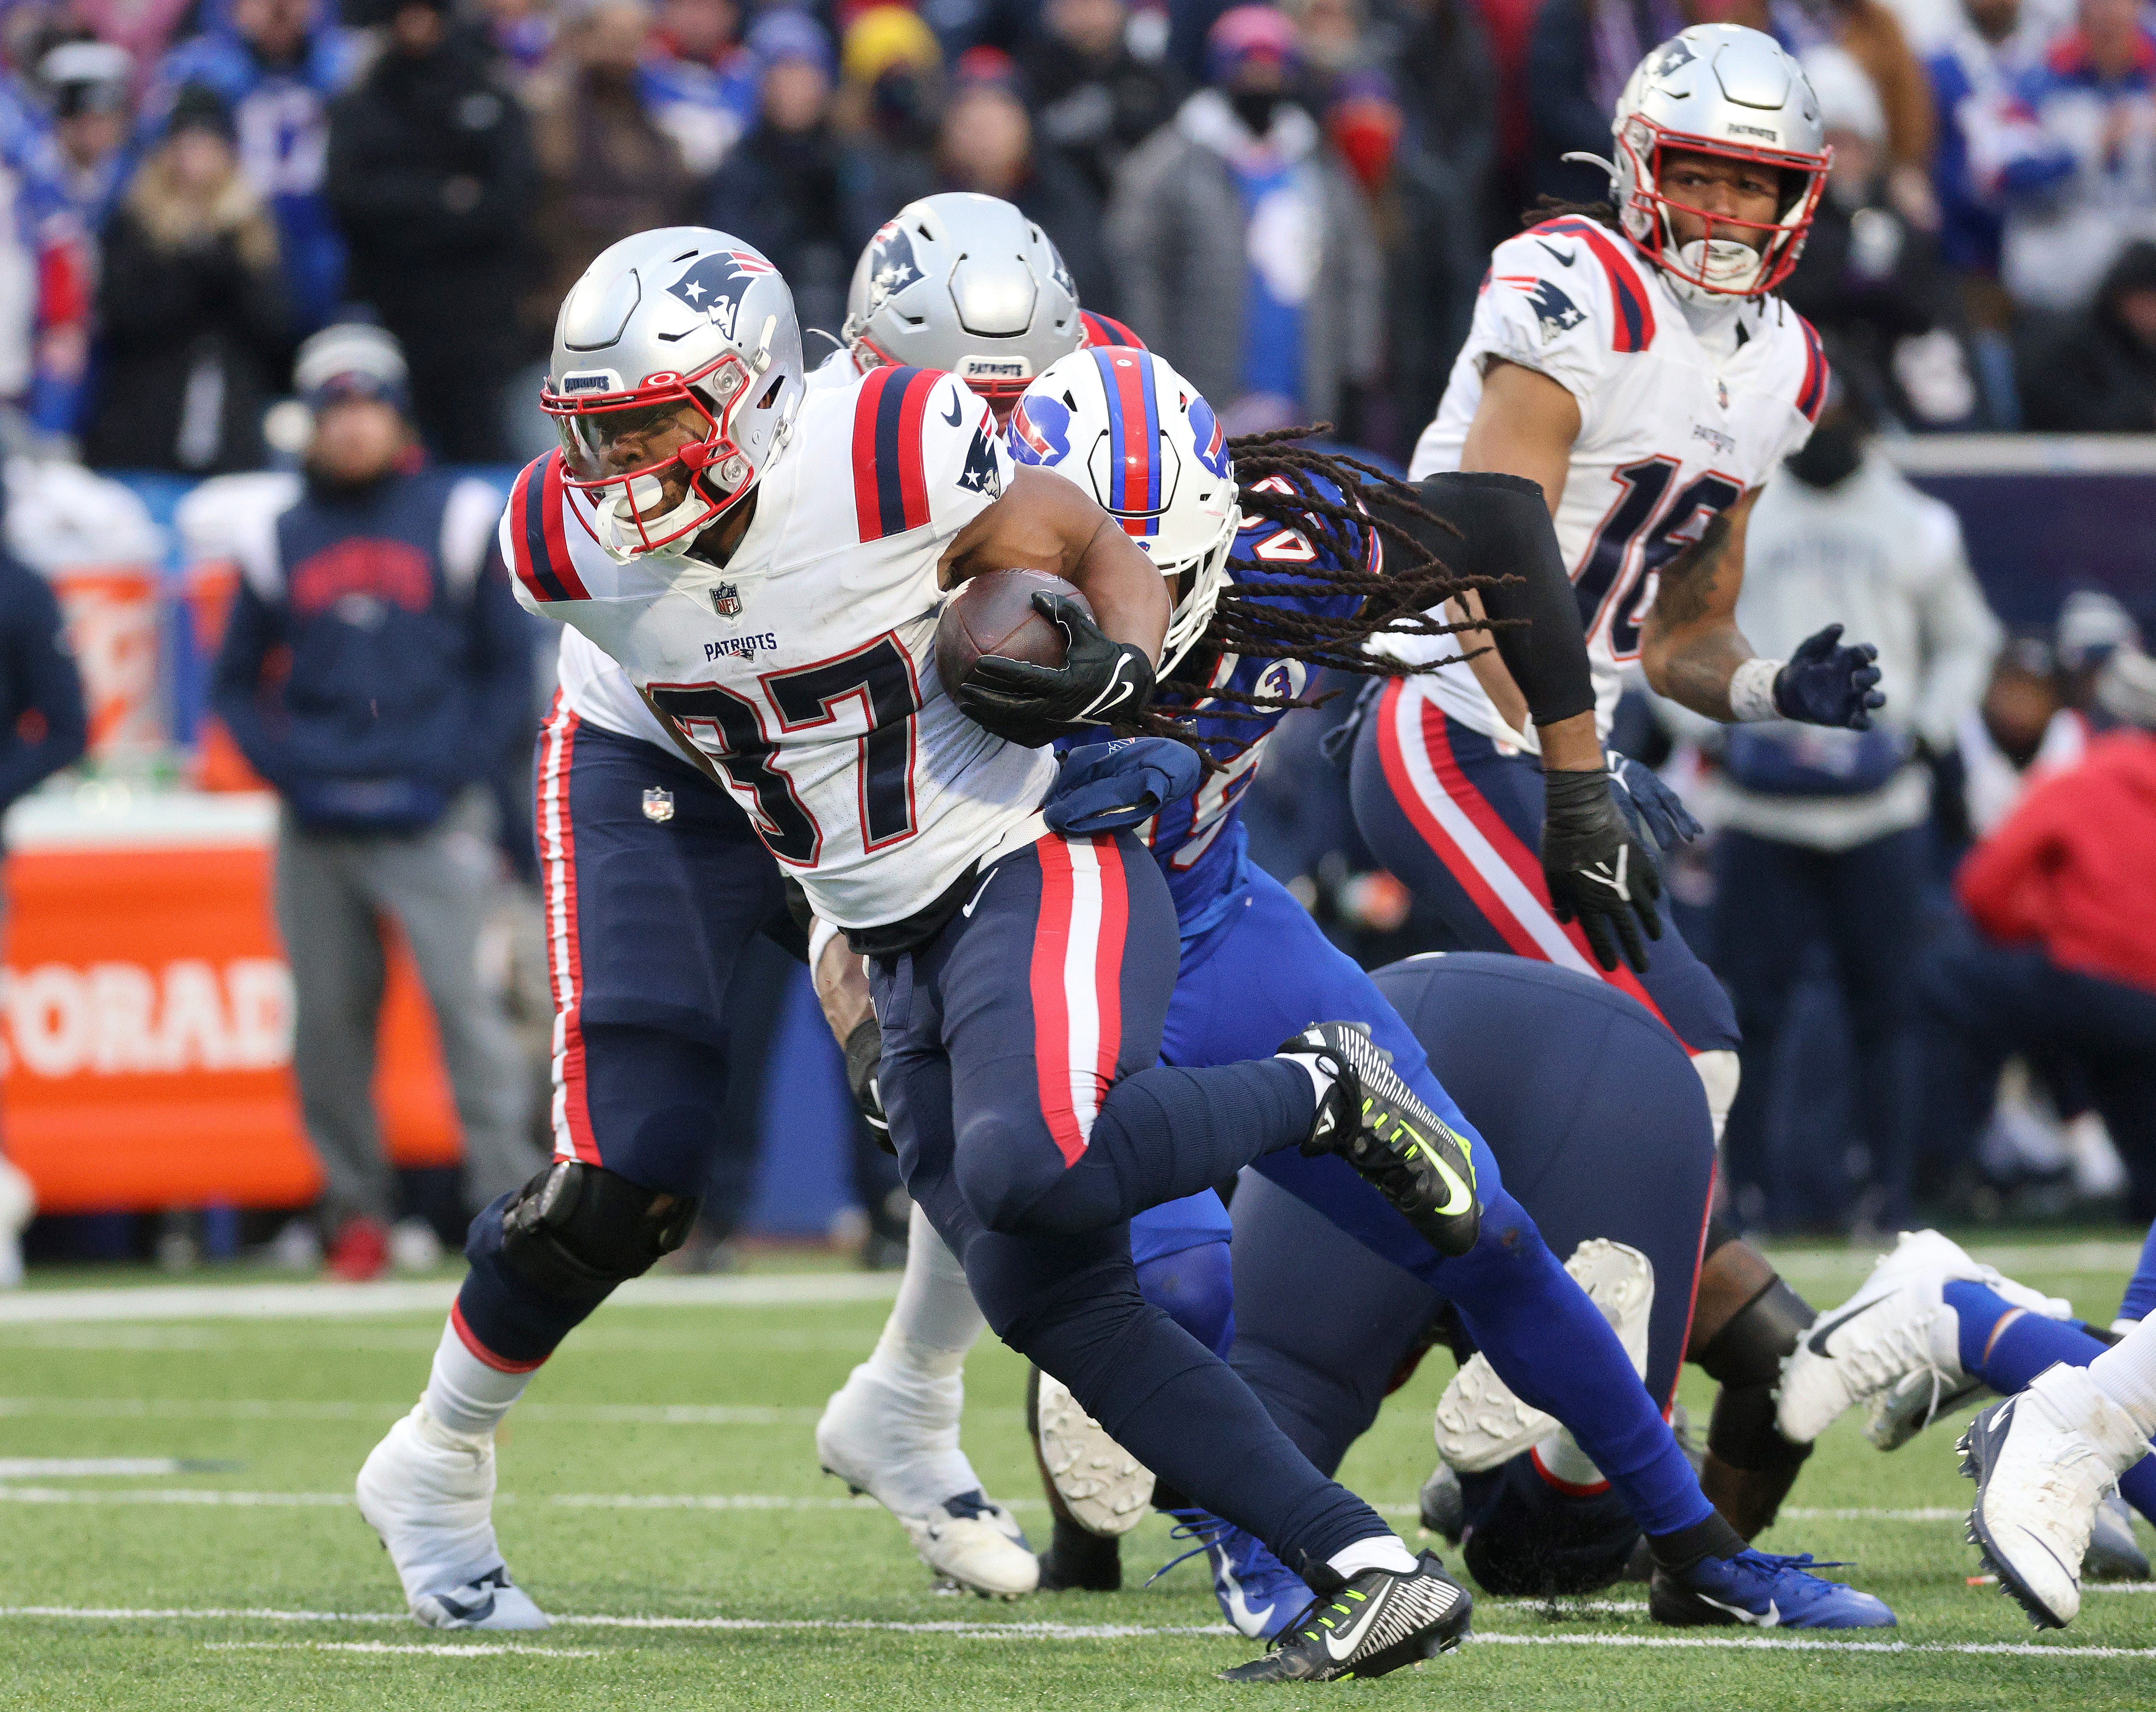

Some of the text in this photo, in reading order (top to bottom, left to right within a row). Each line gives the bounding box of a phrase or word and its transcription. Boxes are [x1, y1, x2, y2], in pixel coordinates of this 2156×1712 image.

[717, 598, 739, 613] NFL
[704, 632, 778, 662] PATRIOTS
[1265, 665, 1292, 700] 3
[646, 629, 923, 868] 37
